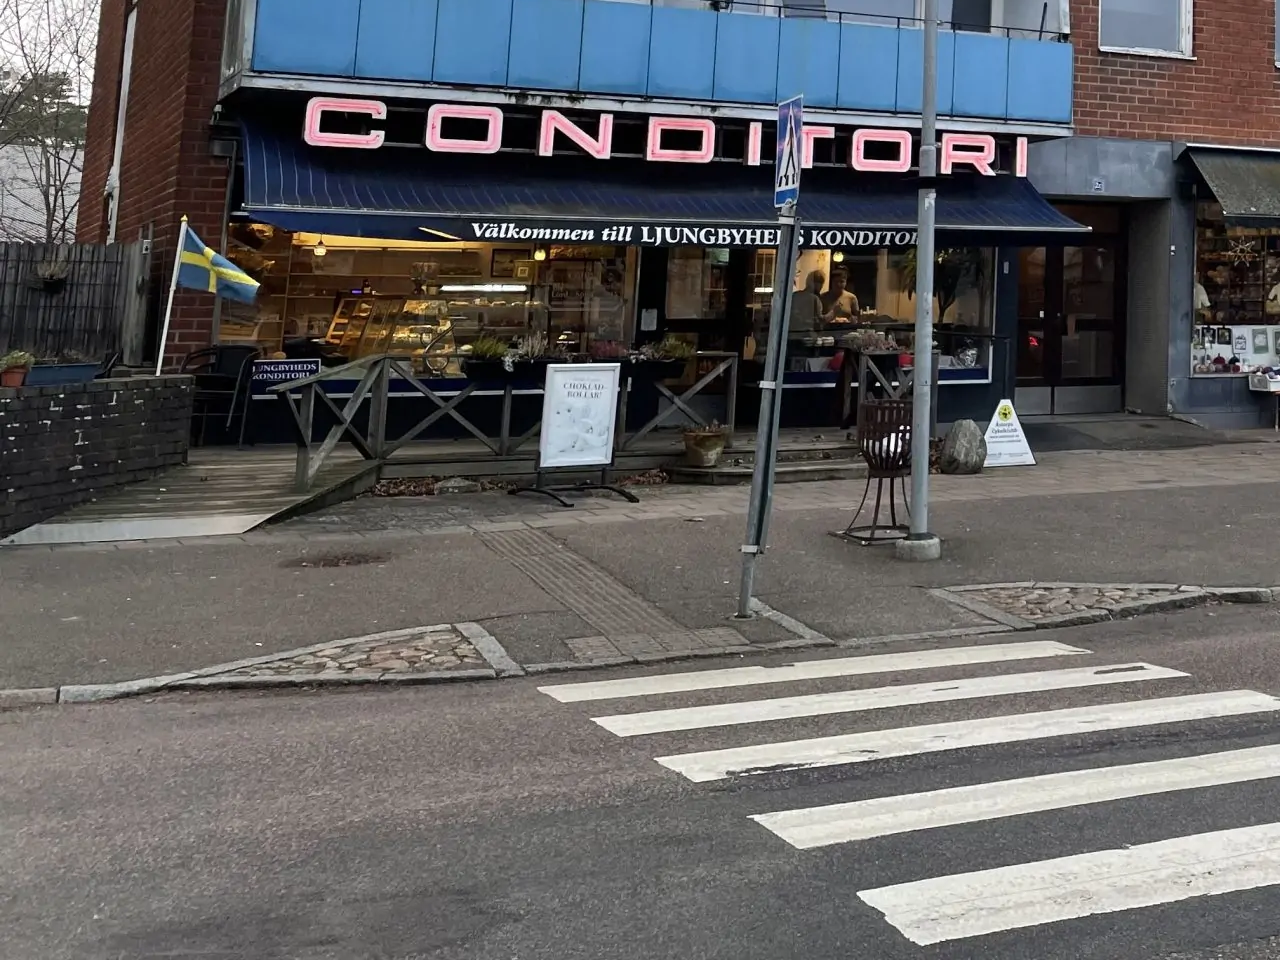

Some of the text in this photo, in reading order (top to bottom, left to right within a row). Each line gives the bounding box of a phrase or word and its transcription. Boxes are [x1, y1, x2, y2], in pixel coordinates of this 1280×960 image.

[304, 96, 1028, 177] CONDITORI
[471, 222, 594, 241] Välkommen
[601, 226, 633, 242] till
